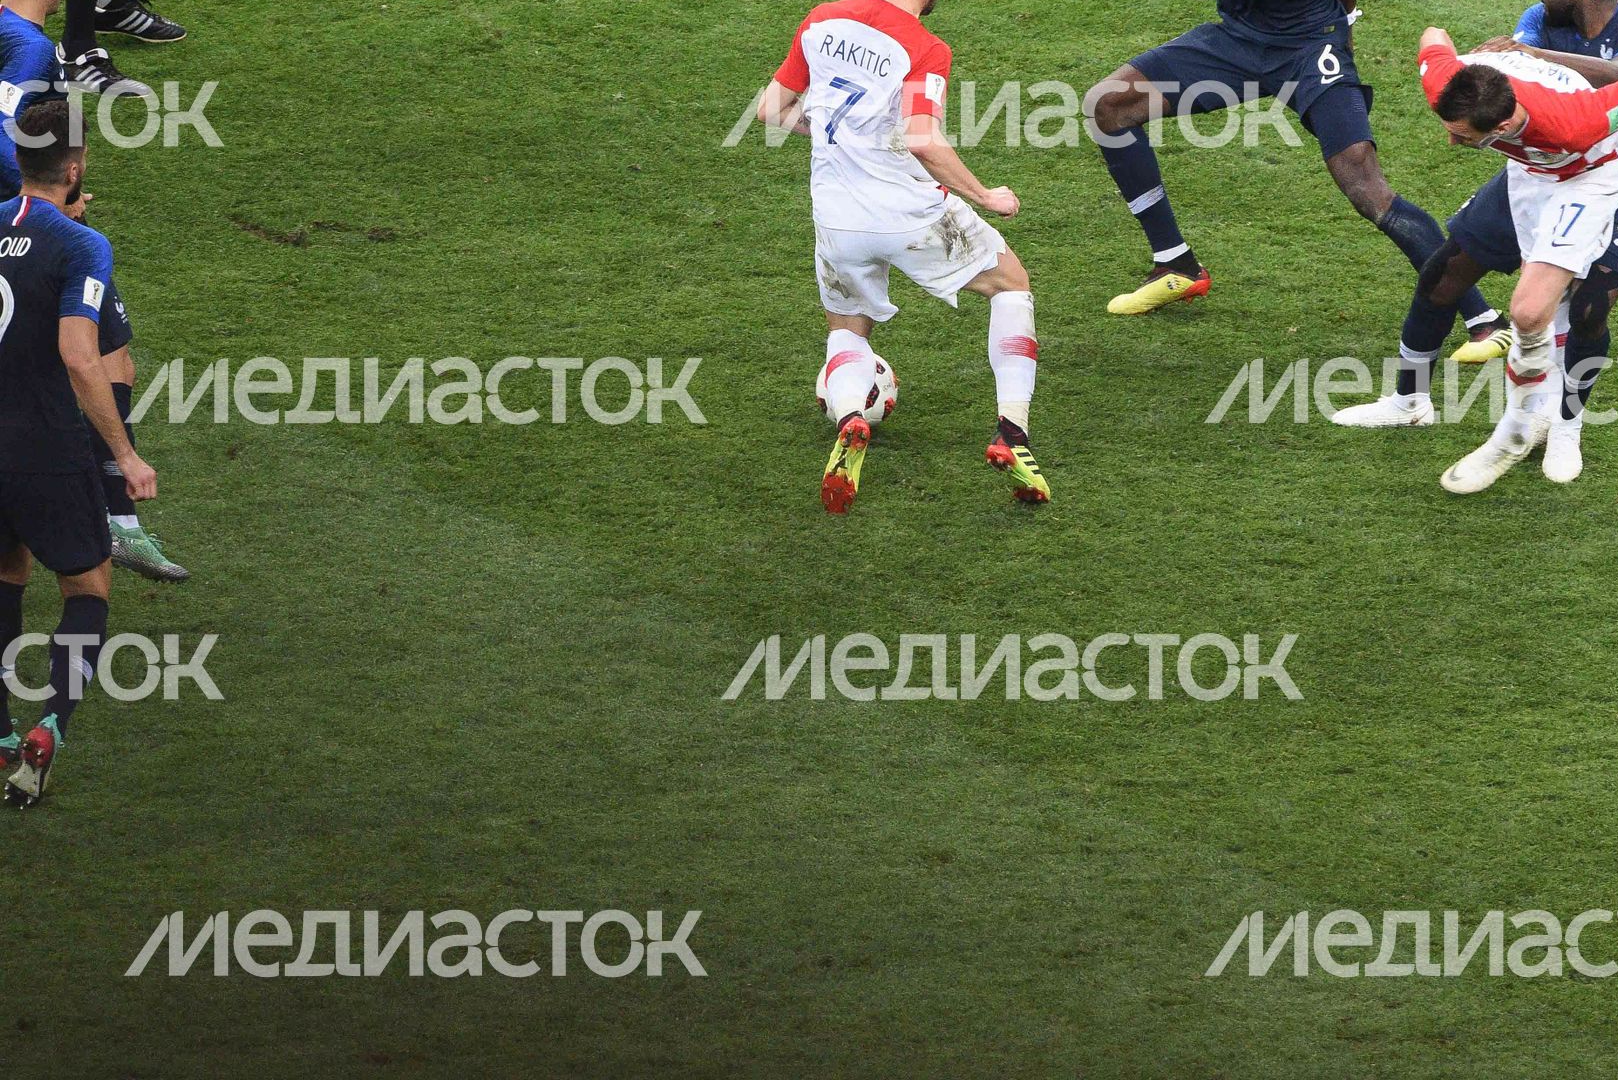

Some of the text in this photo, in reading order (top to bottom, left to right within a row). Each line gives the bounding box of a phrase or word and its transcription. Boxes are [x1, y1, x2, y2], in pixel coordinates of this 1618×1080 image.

[820, 34, 892, 78] RAKITIĆ
[1318, 44, 1341, 76] 6
[824, 76, 868, 145] 7
[1552, 202, 1586, 237] 17
